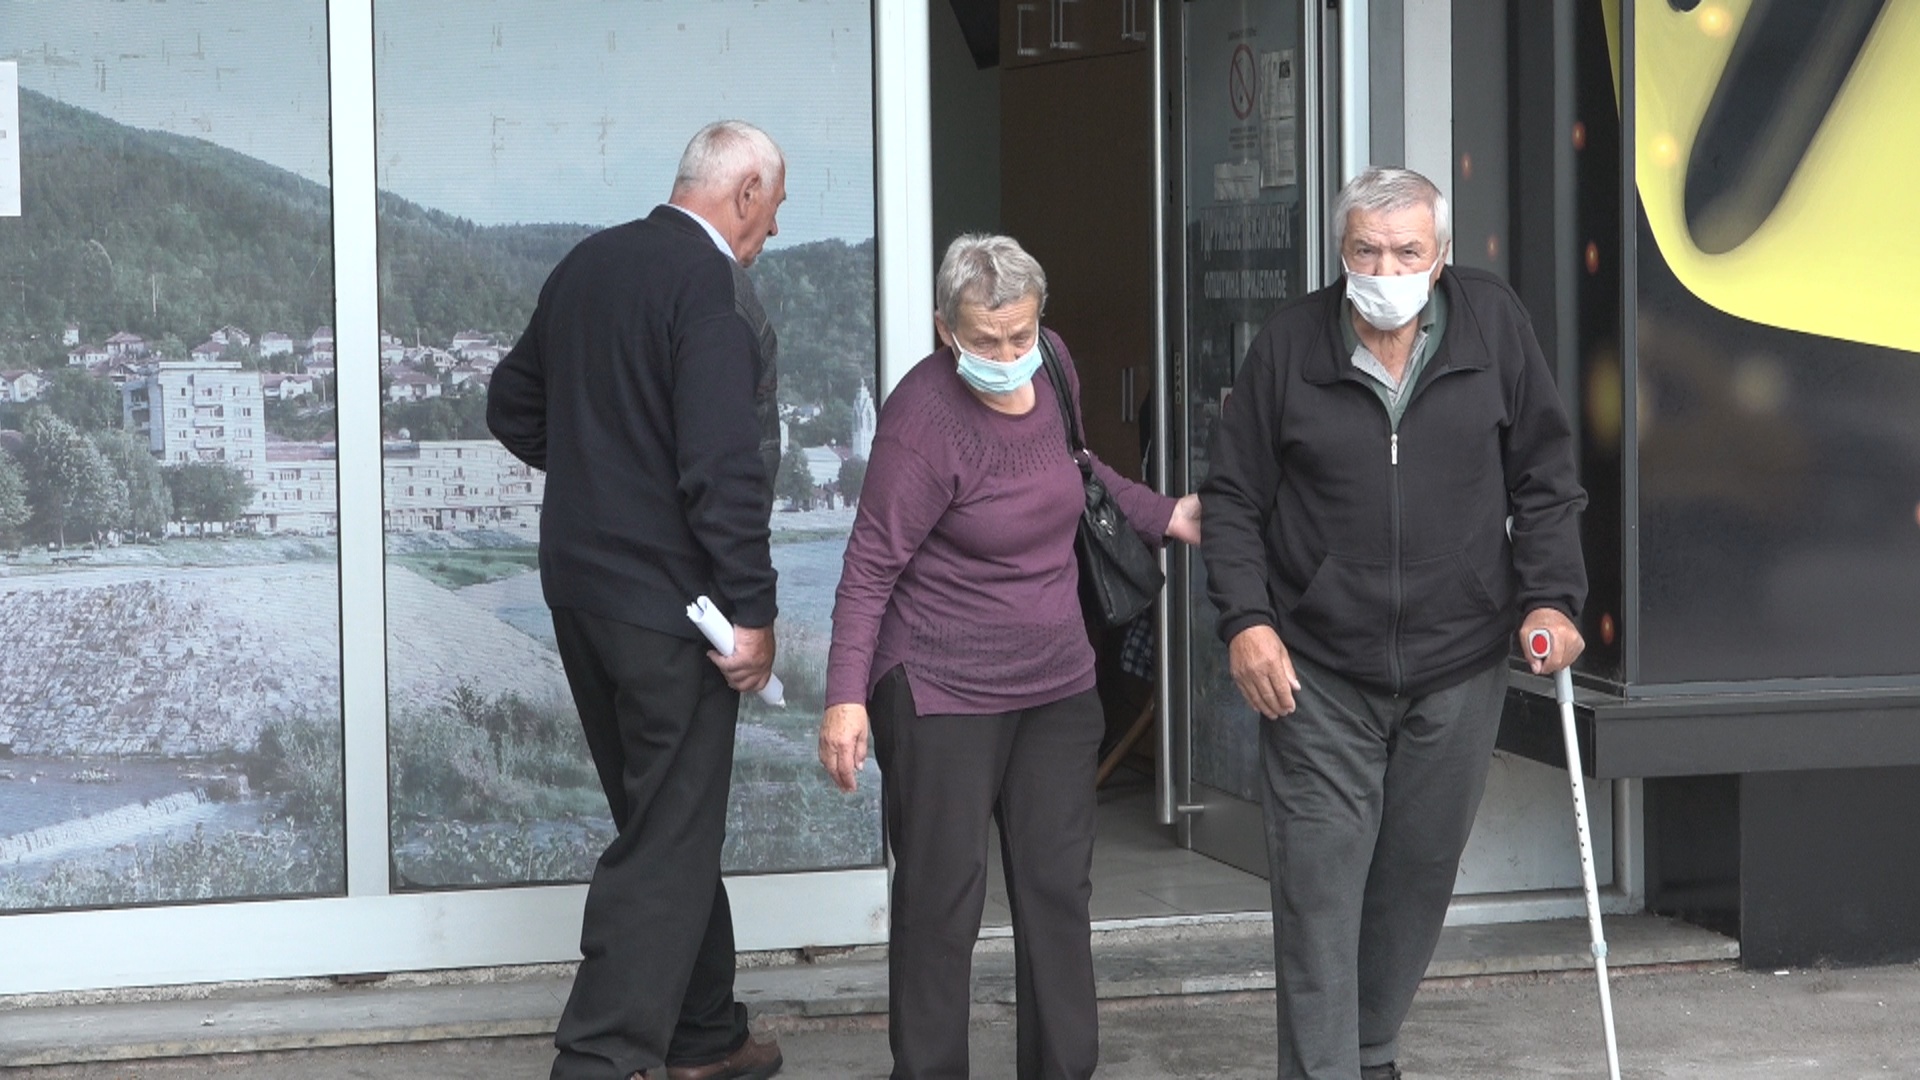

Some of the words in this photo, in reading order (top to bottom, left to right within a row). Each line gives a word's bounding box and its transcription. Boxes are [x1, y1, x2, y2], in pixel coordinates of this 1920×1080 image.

[1243, 205, 1291, 250] ПЕНЗИОНЕРА
[1204, 271, 1240, 299] ОПШТИНА
[1241, 269, 1287, 299] ПРИЈЕПОЉЕ
